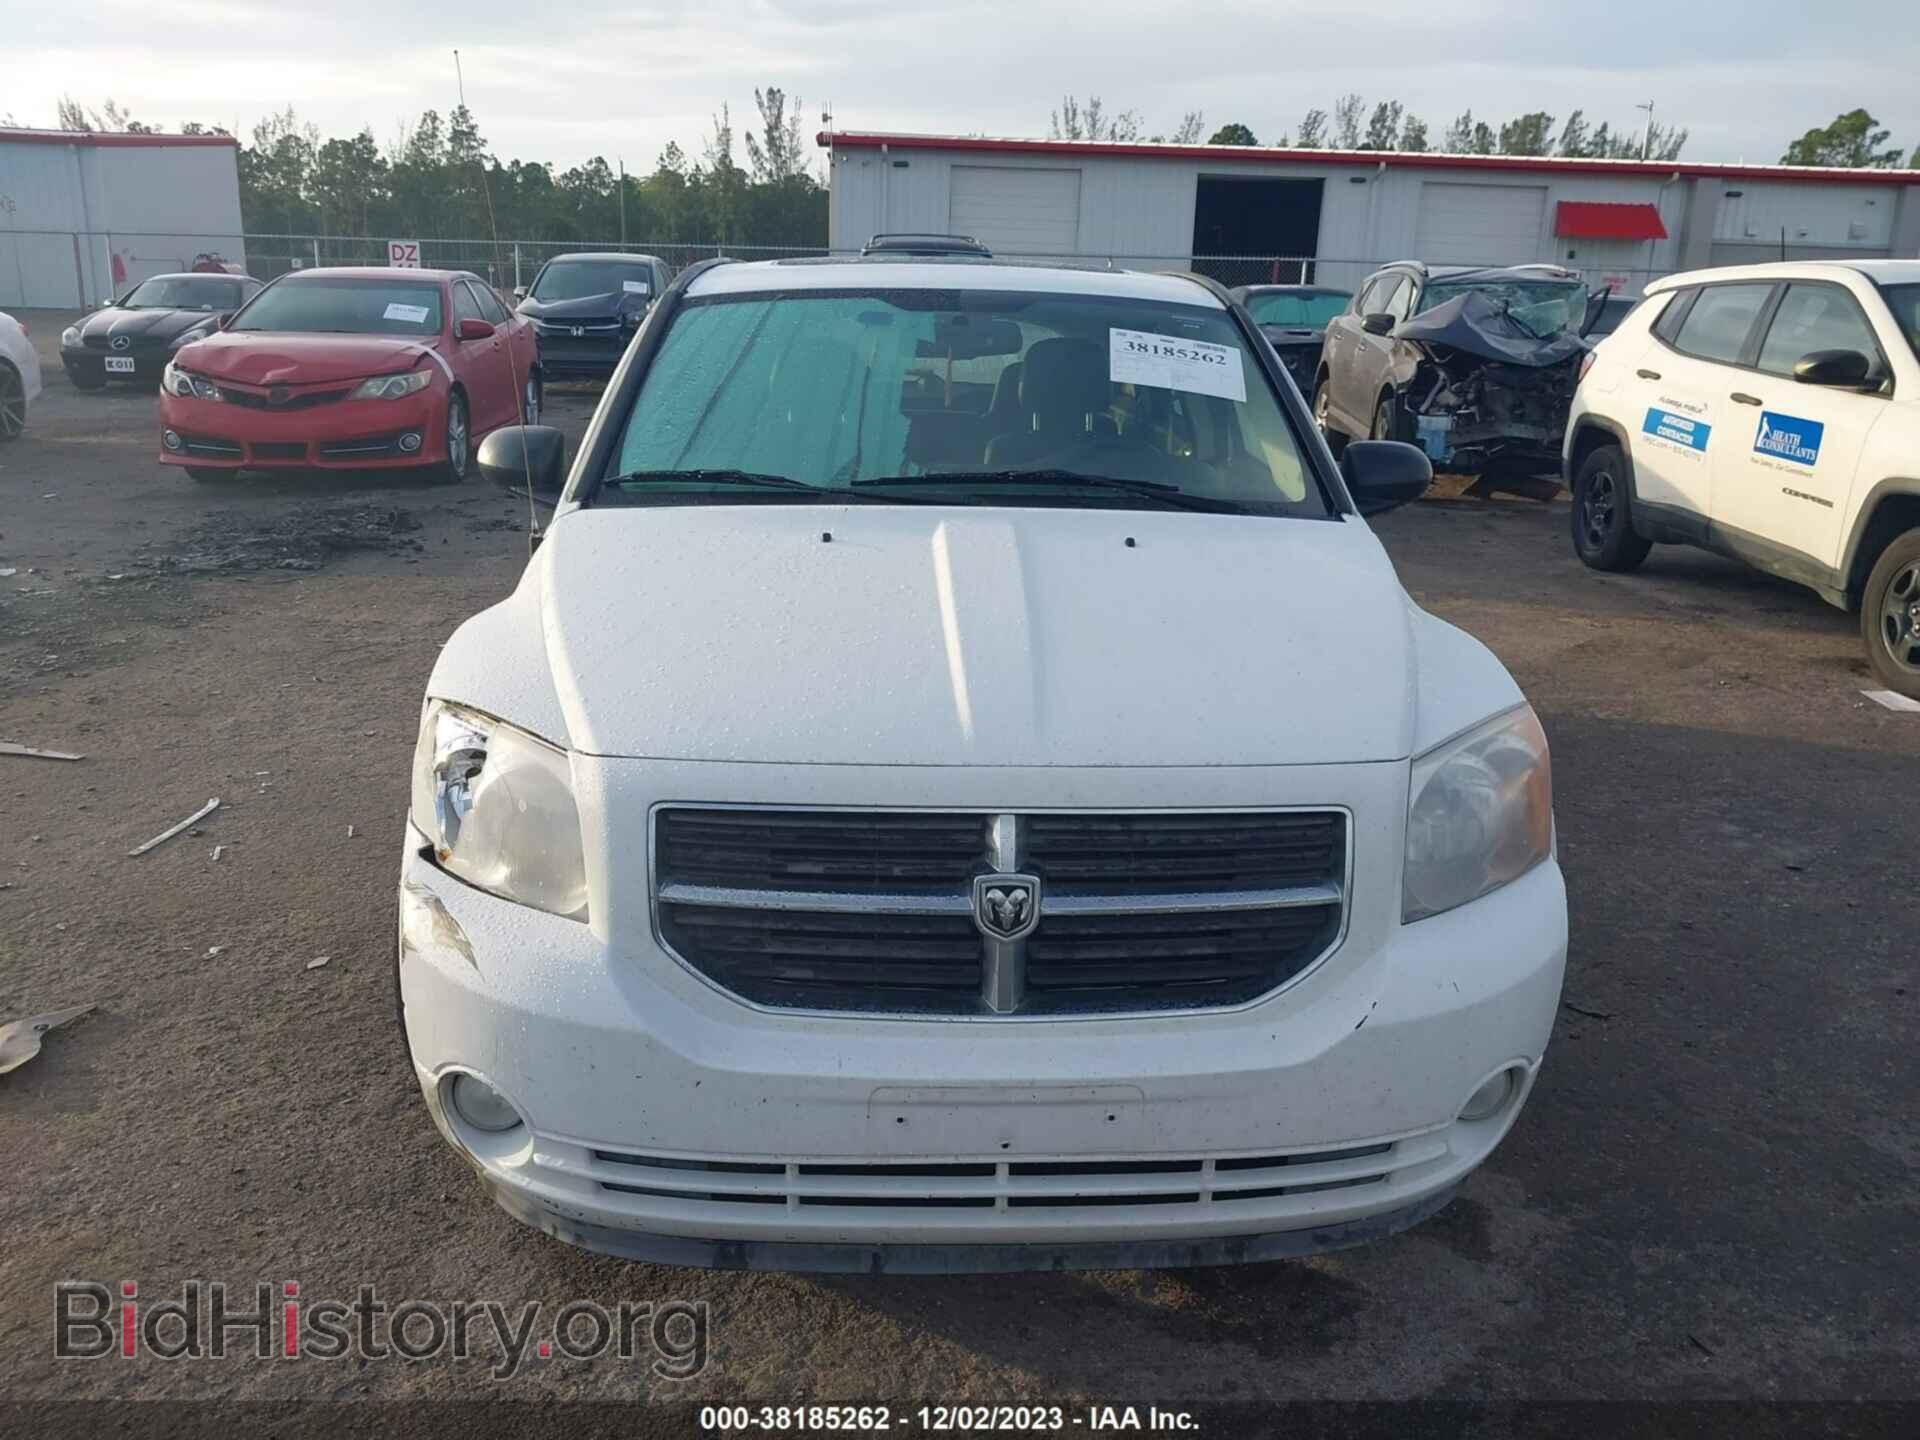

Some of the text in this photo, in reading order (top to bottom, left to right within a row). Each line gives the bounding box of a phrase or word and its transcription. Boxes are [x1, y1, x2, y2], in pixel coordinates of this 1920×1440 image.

[391, 244, 418, 261] DZ
[1123, 340, 1227, 366] 38185262
[1772, 429, 1802, 447] HEATH
[1758, 438, 1817, 461] CONSULTANTS
